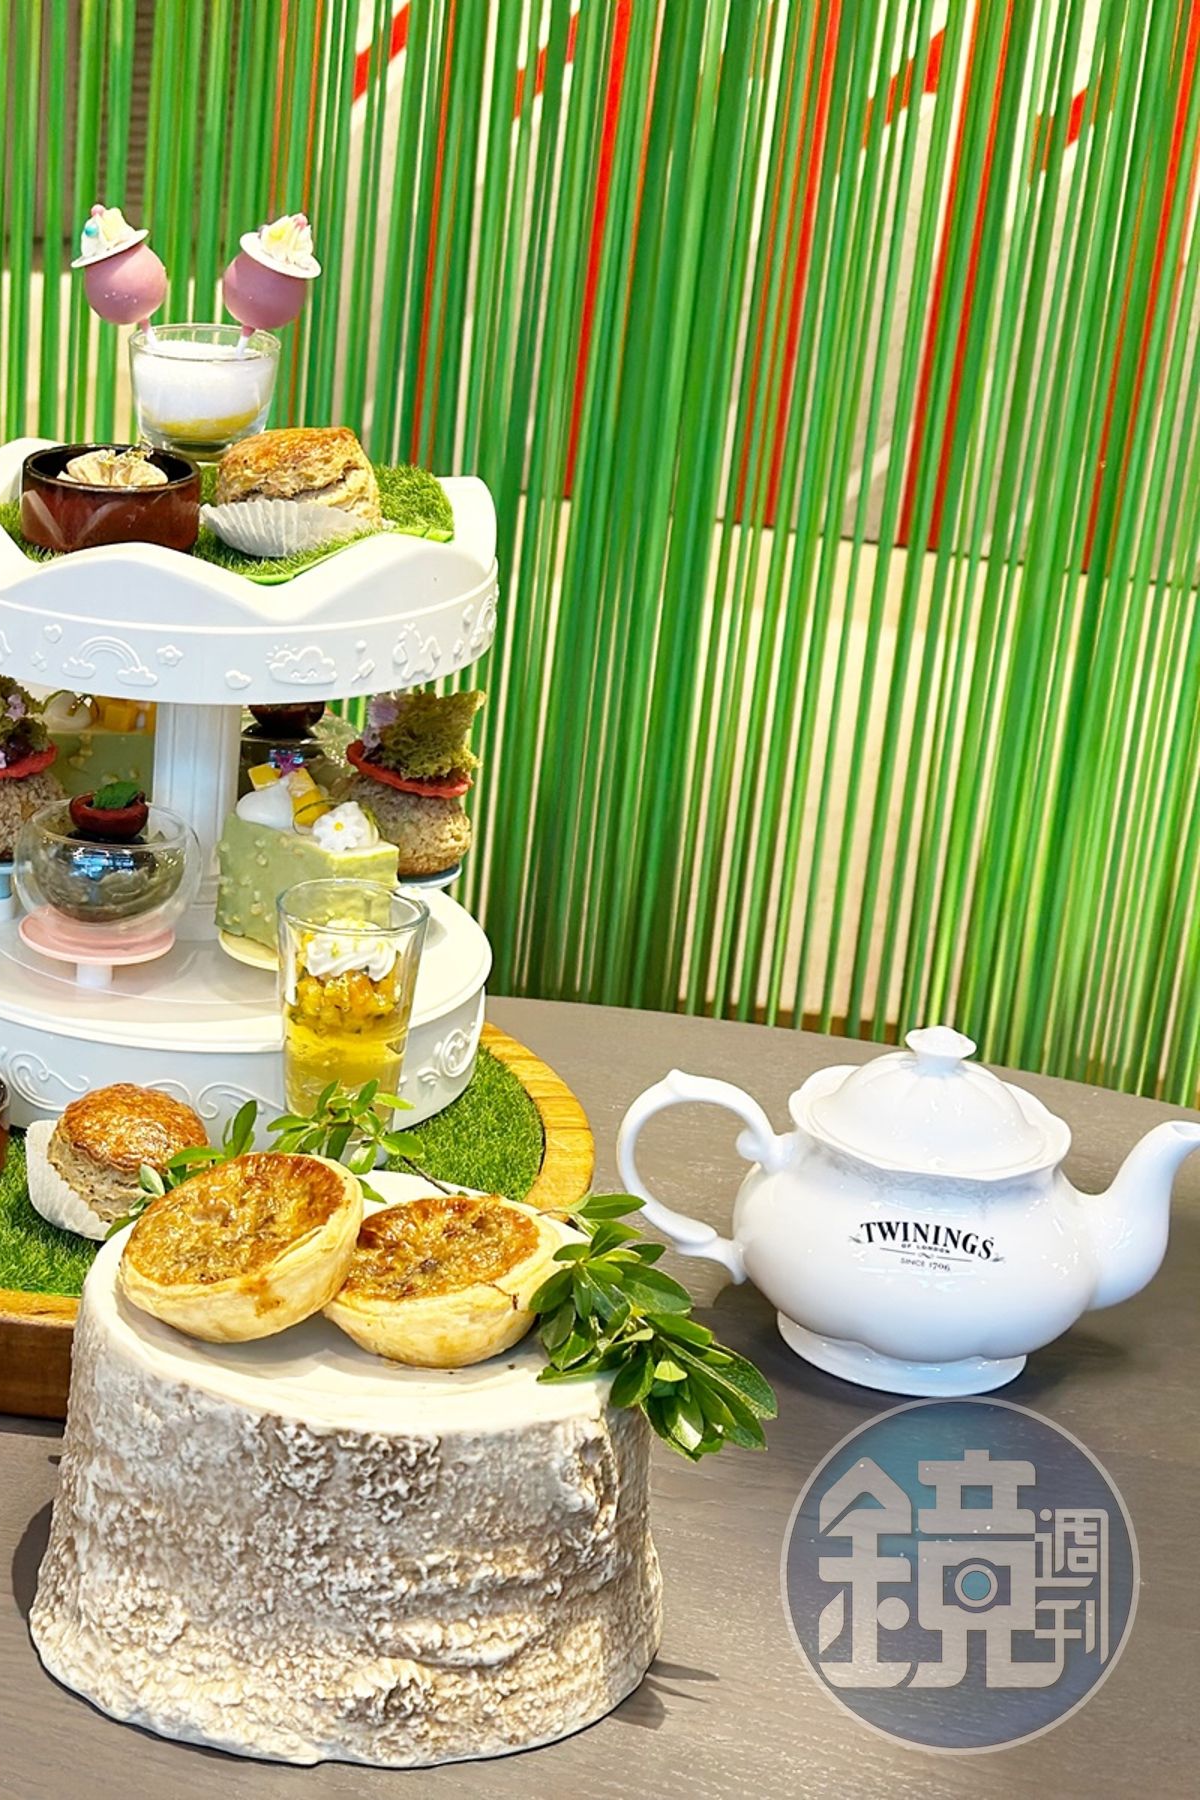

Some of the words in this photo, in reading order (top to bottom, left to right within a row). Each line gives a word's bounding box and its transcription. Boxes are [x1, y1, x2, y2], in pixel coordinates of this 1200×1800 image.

[860, 1220, 996, 1261] TWININGS
[900, 1257, 926, 1268] SINCE
[928, 1261, 951, 1272] 1706
